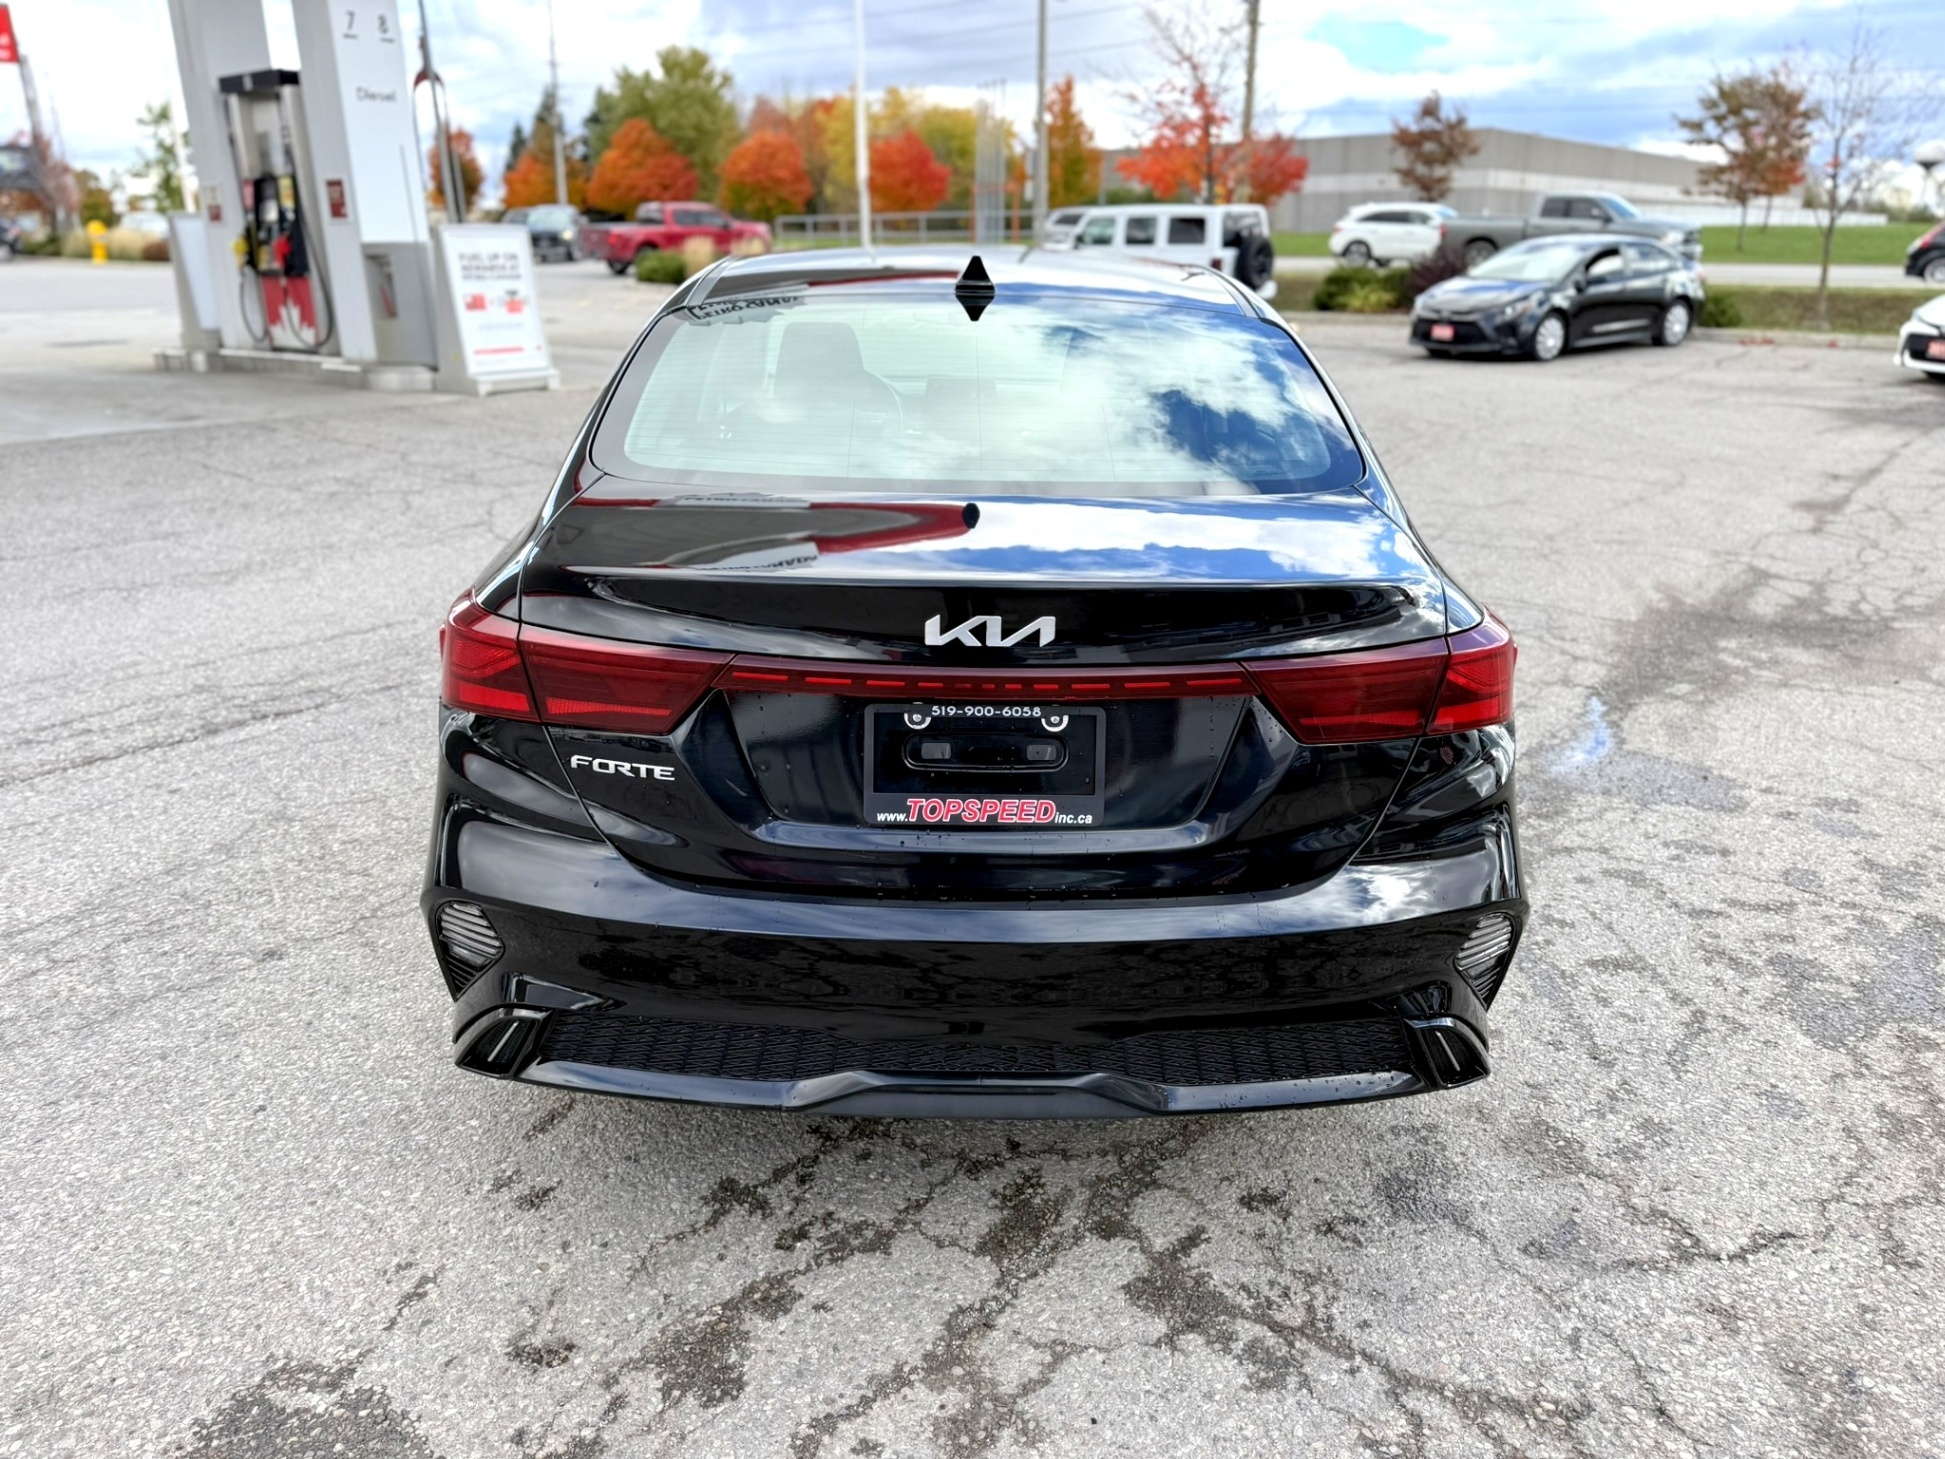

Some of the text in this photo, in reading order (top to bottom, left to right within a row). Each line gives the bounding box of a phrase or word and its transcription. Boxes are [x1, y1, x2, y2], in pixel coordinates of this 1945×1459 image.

[345, 10, 356, 31] 7
[356, 86, 396, 102] Diesel
[924, 614, 1056, 648] KIA
[931, 705, 1042, 718] 519-900-6058
[570, 754, 676, 781] FORTE
